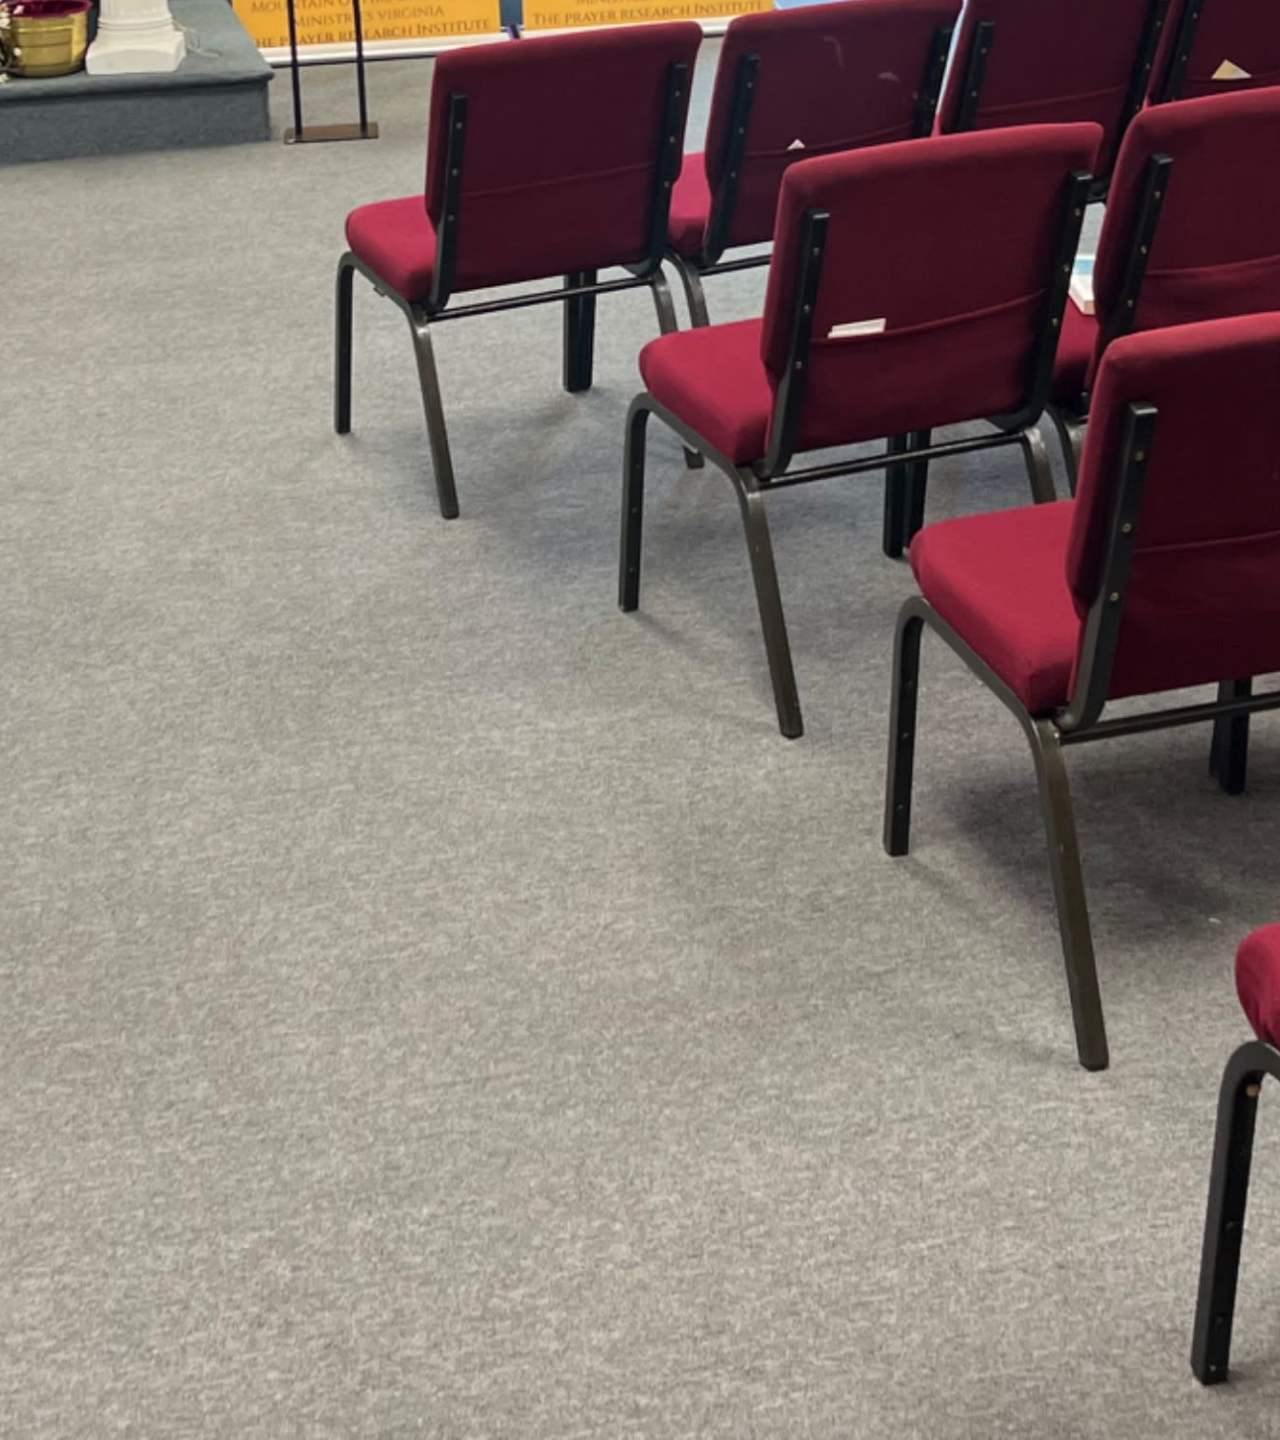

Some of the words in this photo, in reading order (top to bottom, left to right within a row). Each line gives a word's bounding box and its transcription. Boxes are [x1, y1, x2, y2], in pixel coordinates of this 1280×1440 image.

[378, 5, 444, 21] VIRGINIA
[532, 11, 560, 26] THE
[564, 8, 618, 24] PRAYER
[620, 4, 690, 21] RESEARCH
[695, 0, 762, 15] INSTITUTE
[279, 31, 334, 47] PAYER
[339, 25, 412, 44] REEARCH
[414, 18, 490, 37] INSTITUTE
